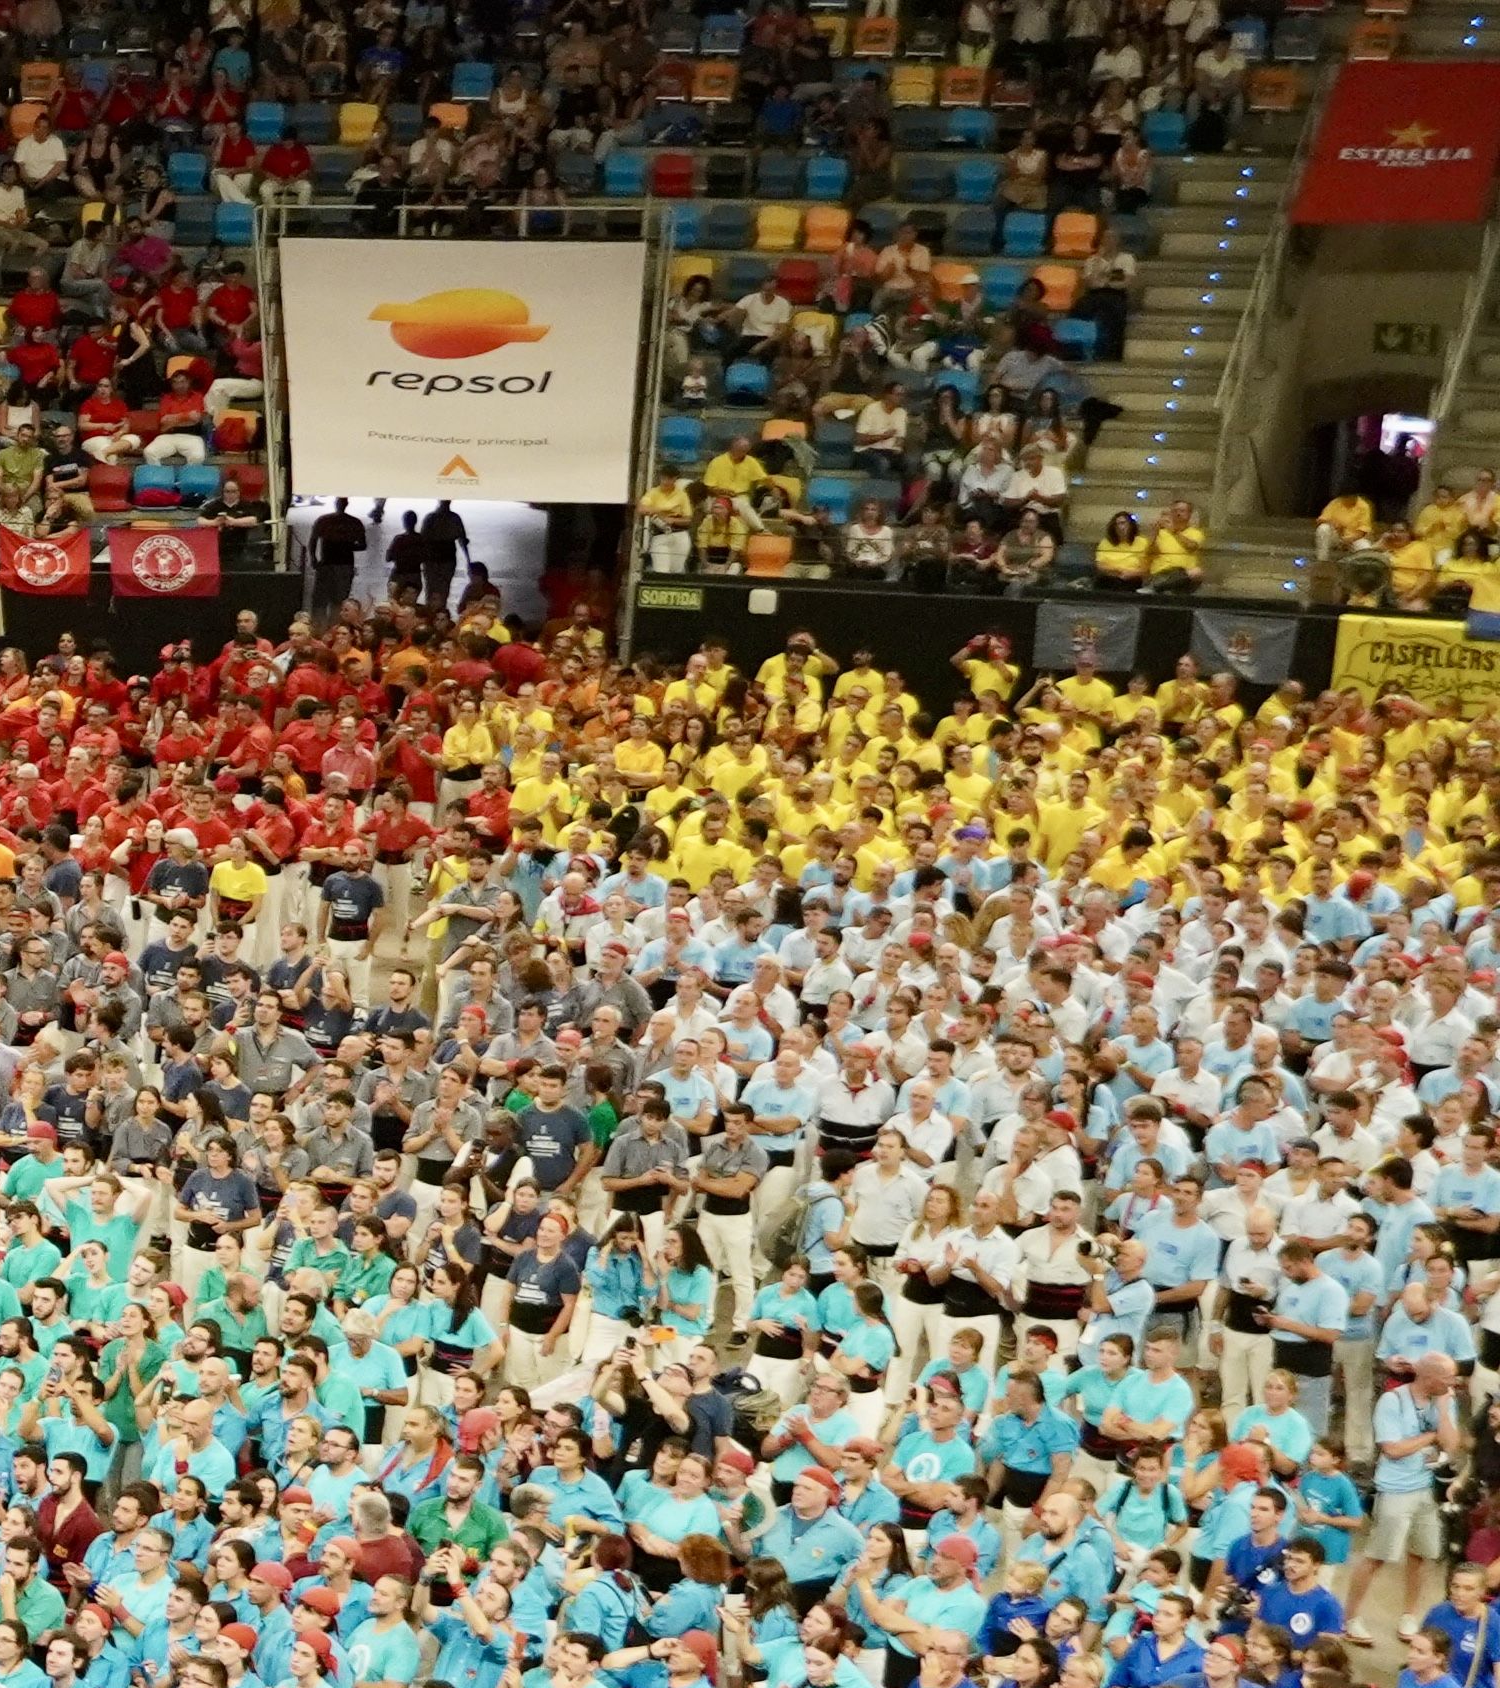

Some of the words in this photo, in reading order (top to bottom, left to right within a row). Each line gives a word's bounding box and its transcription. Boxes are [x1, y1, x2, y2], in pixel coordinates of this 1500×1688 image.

[1338, 147, 1474, 160] ESTRELLA
[366, 371, 552, 395] repsol
[368, 430, 471, 444] Patrocinador
[477, 437, 549, 447] principal
[641, 589, 699, 606] SORTIDA
[1370, 643, 1496, 671] CASTELLERS
